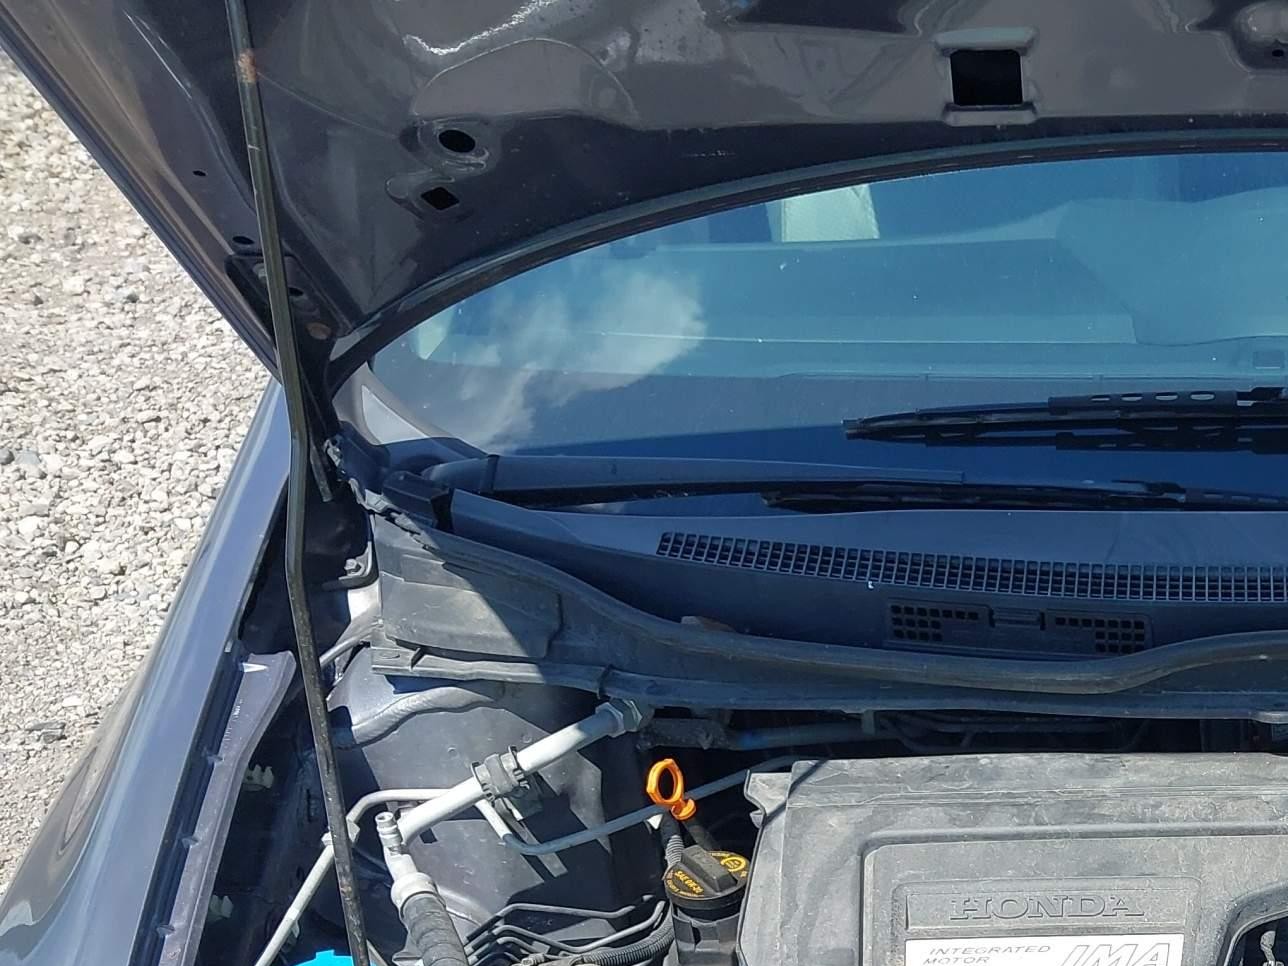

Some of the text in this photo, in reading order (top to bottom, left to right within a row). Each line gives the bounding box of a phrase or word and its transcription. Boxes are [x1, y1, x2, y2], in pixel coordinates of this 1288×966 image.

[950, 895, 1144, 920] HONDA
[929, 945, 1051, 955] INTEGRATED
[922, 956, 990, 965] MOTOR
